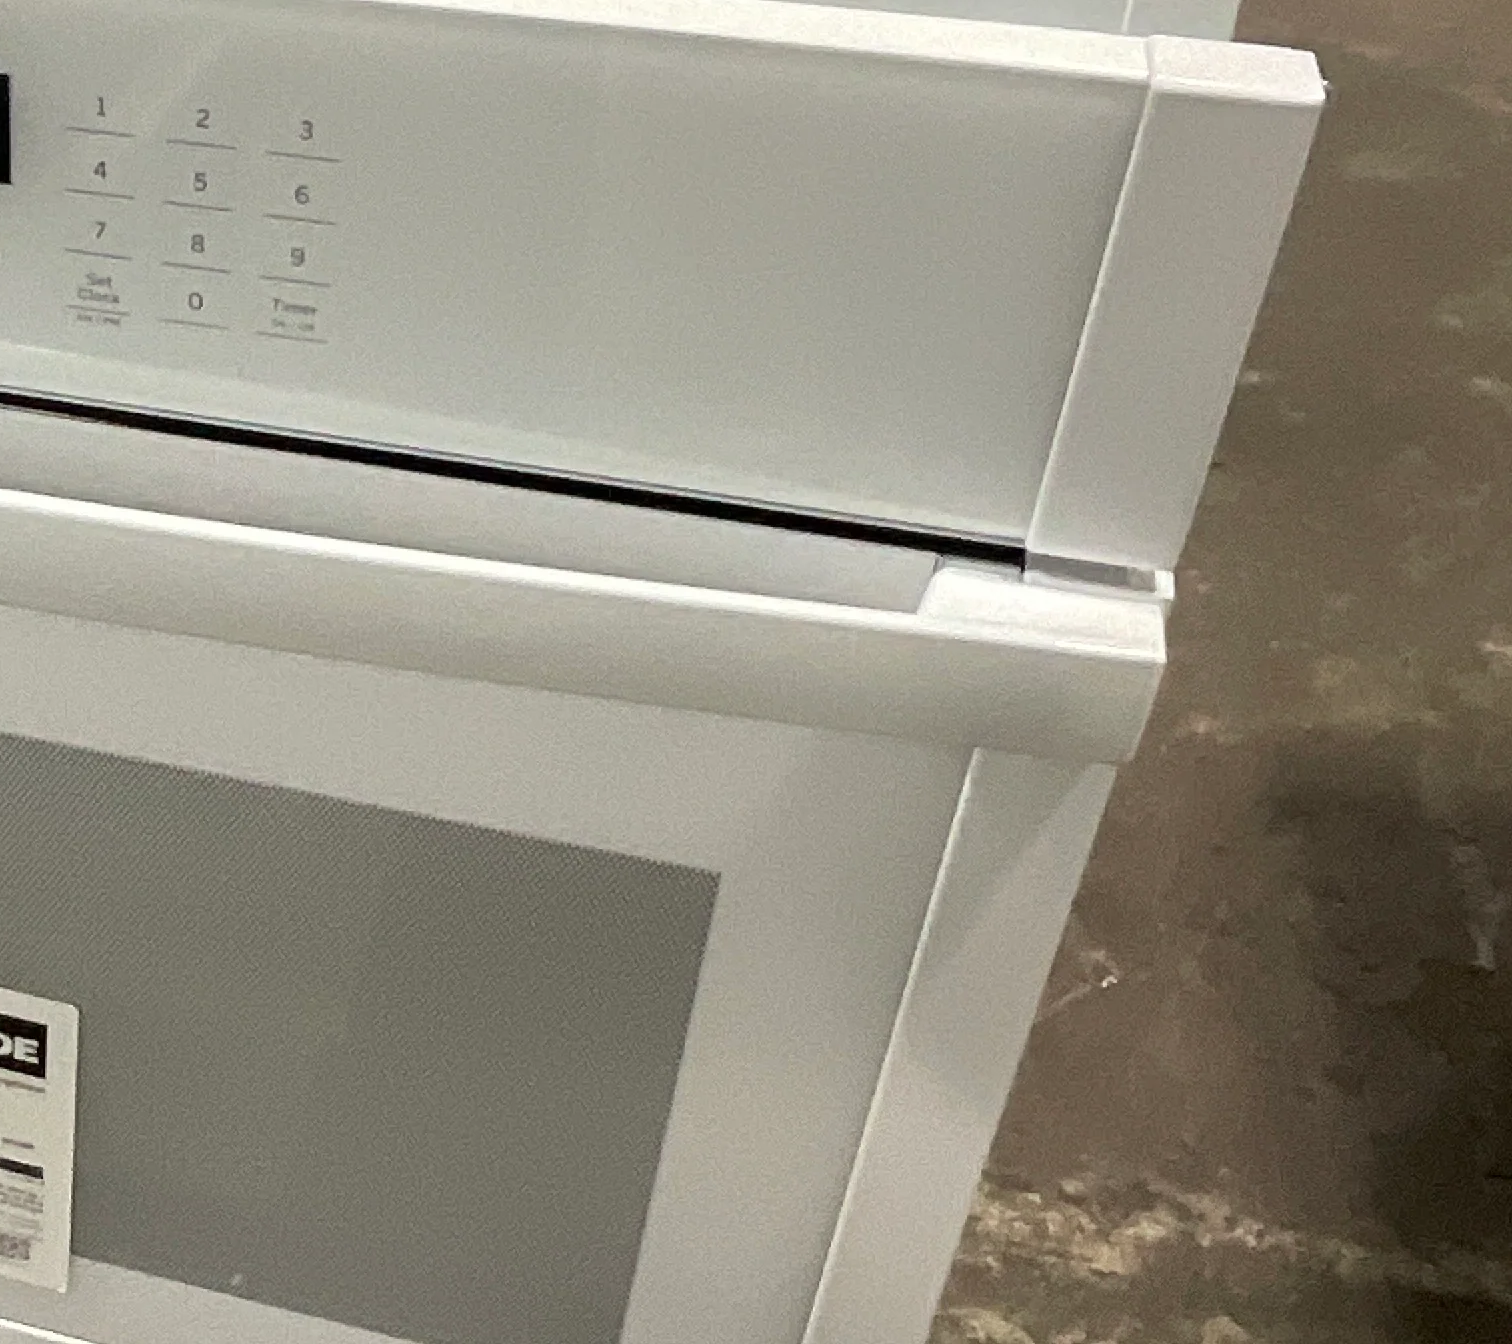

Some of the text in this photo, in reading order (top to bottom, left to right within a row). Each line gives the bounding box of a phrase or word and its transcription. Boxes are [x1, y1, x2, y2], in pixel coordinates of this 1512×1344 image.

[96, 97, 106, 116] 1
[195, 109, 210, 129] 2
[299, 121, 314, 141] 3
[93, 161, 107, 179] 4
[193, 173, 208, 192] 5
[294, 186, 310, 204] 6
[94, 222, 106, 239] 7
[190, 234, 205, 253] 8
[290, 248, 306, 266] 9
[188, 292, 203, 311] 0
